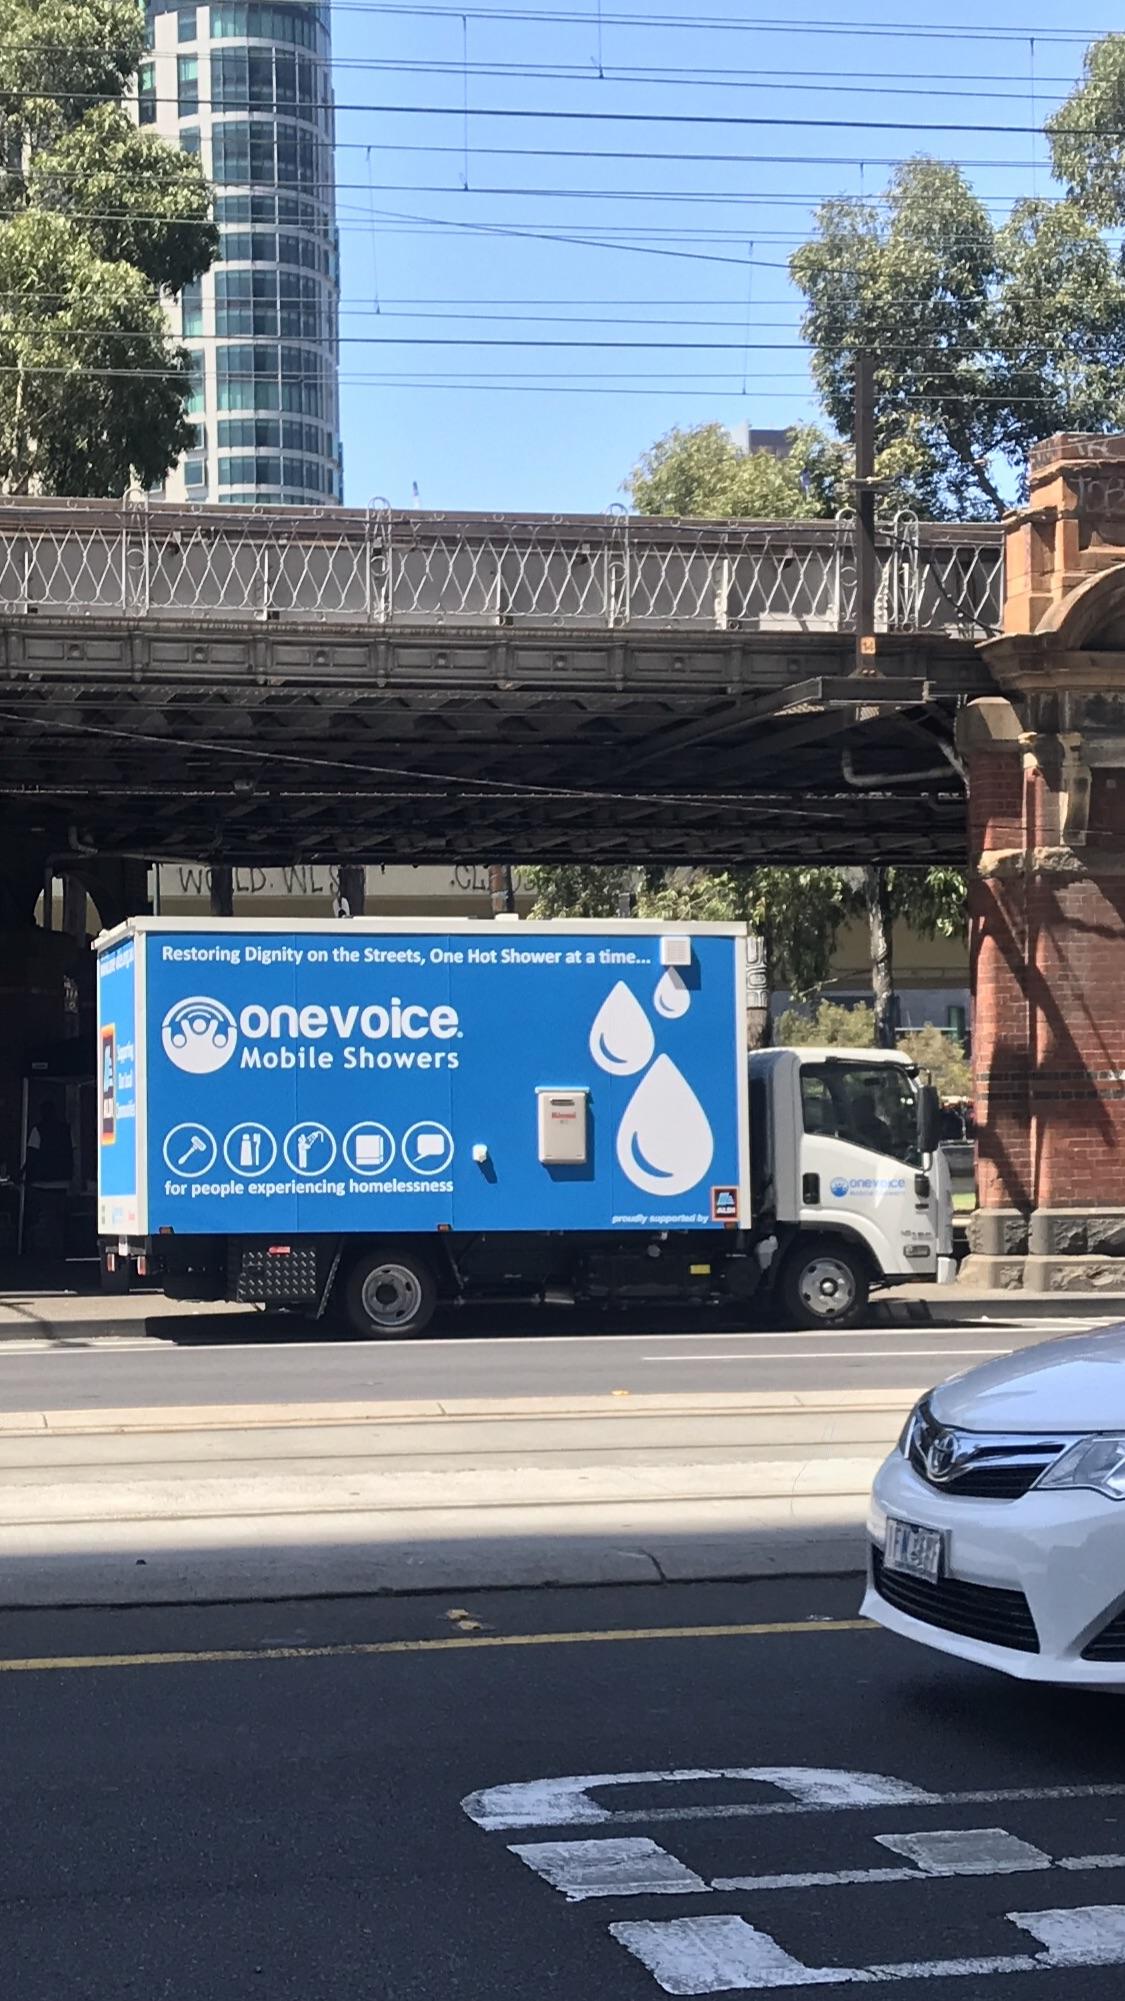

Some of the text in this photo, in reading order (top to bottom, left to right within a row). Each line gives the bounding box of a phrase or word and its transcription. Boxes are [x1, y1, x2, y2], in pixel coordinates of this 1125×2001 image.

[162, 946, 651, 966] Restoring Dignity on the Streets, One Hot Shower at a time...
[240, 1046, 459, 1069] Mobile Showers
[164, 1179, 454, 1198] for people experiencing homelessness
[611, 1214, 709, 1224] proudly supported by
